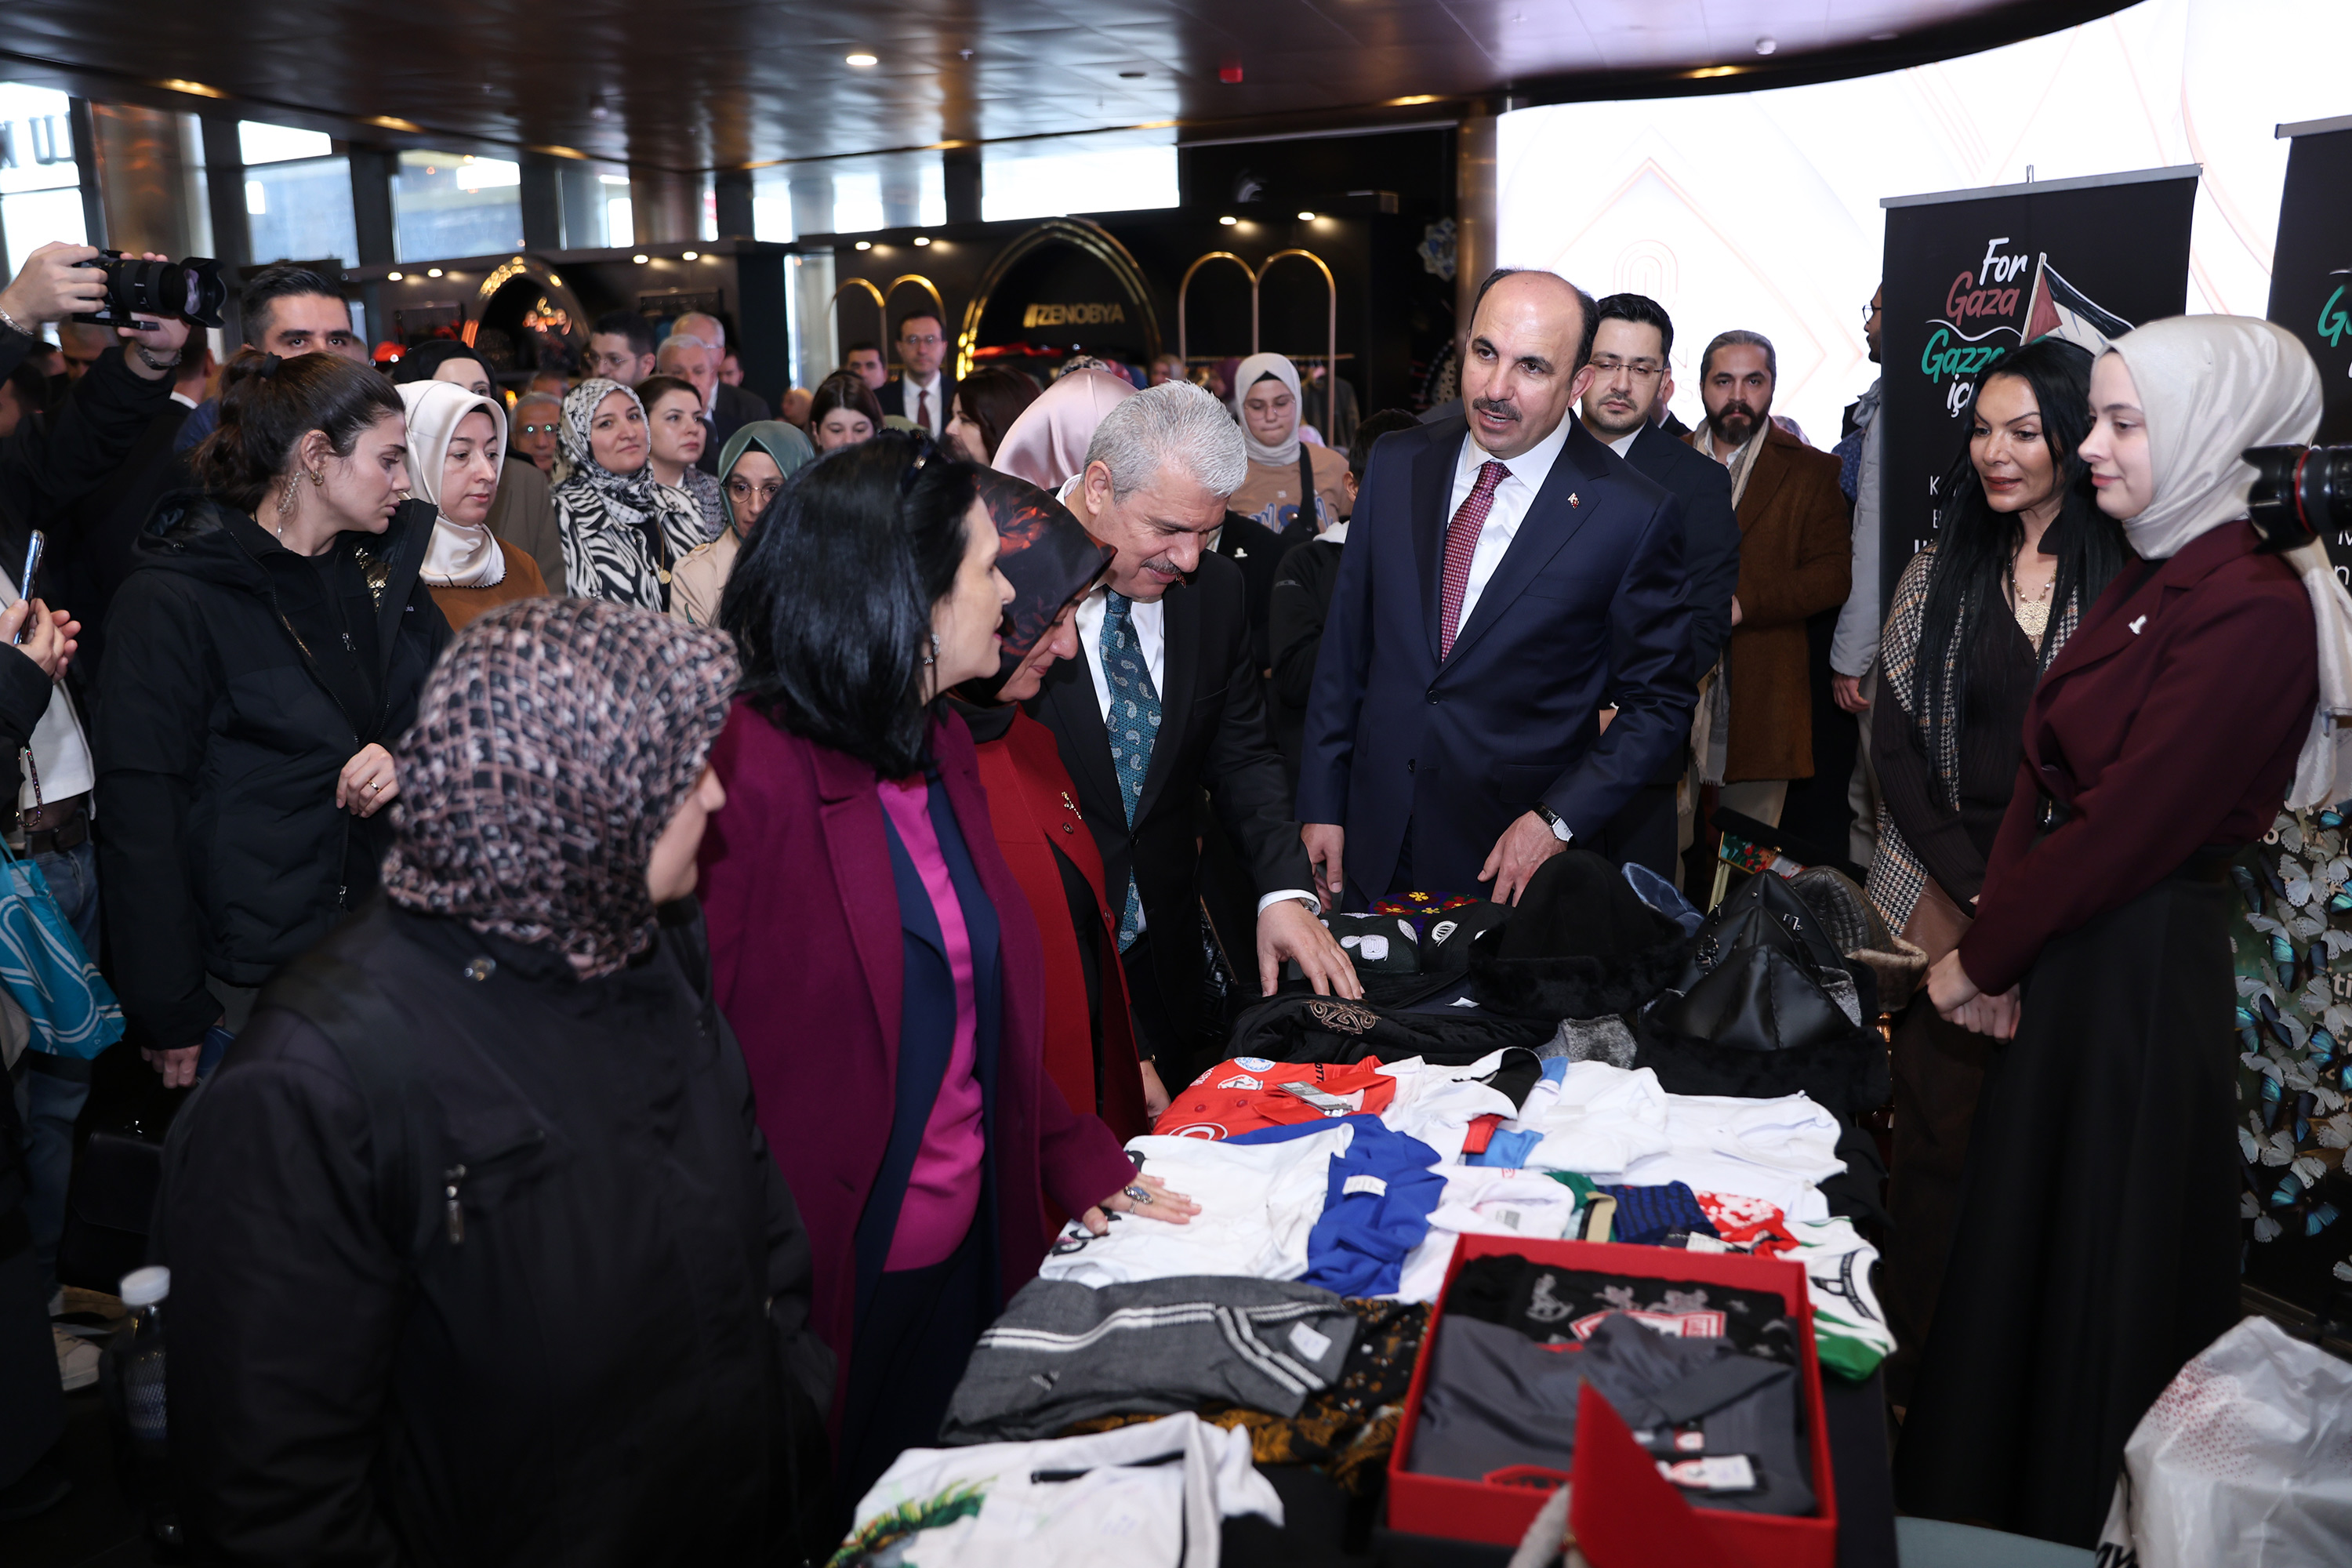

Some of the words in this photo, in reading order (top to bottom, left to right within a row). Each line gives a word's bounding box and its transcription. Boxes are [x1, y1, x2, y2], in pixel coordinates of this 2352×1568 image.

[1980, 238, 2027, 285] For
[1036, 303, 1125, 325] ZENOBYA
[1946, 271, 2020, 326] Gaza
